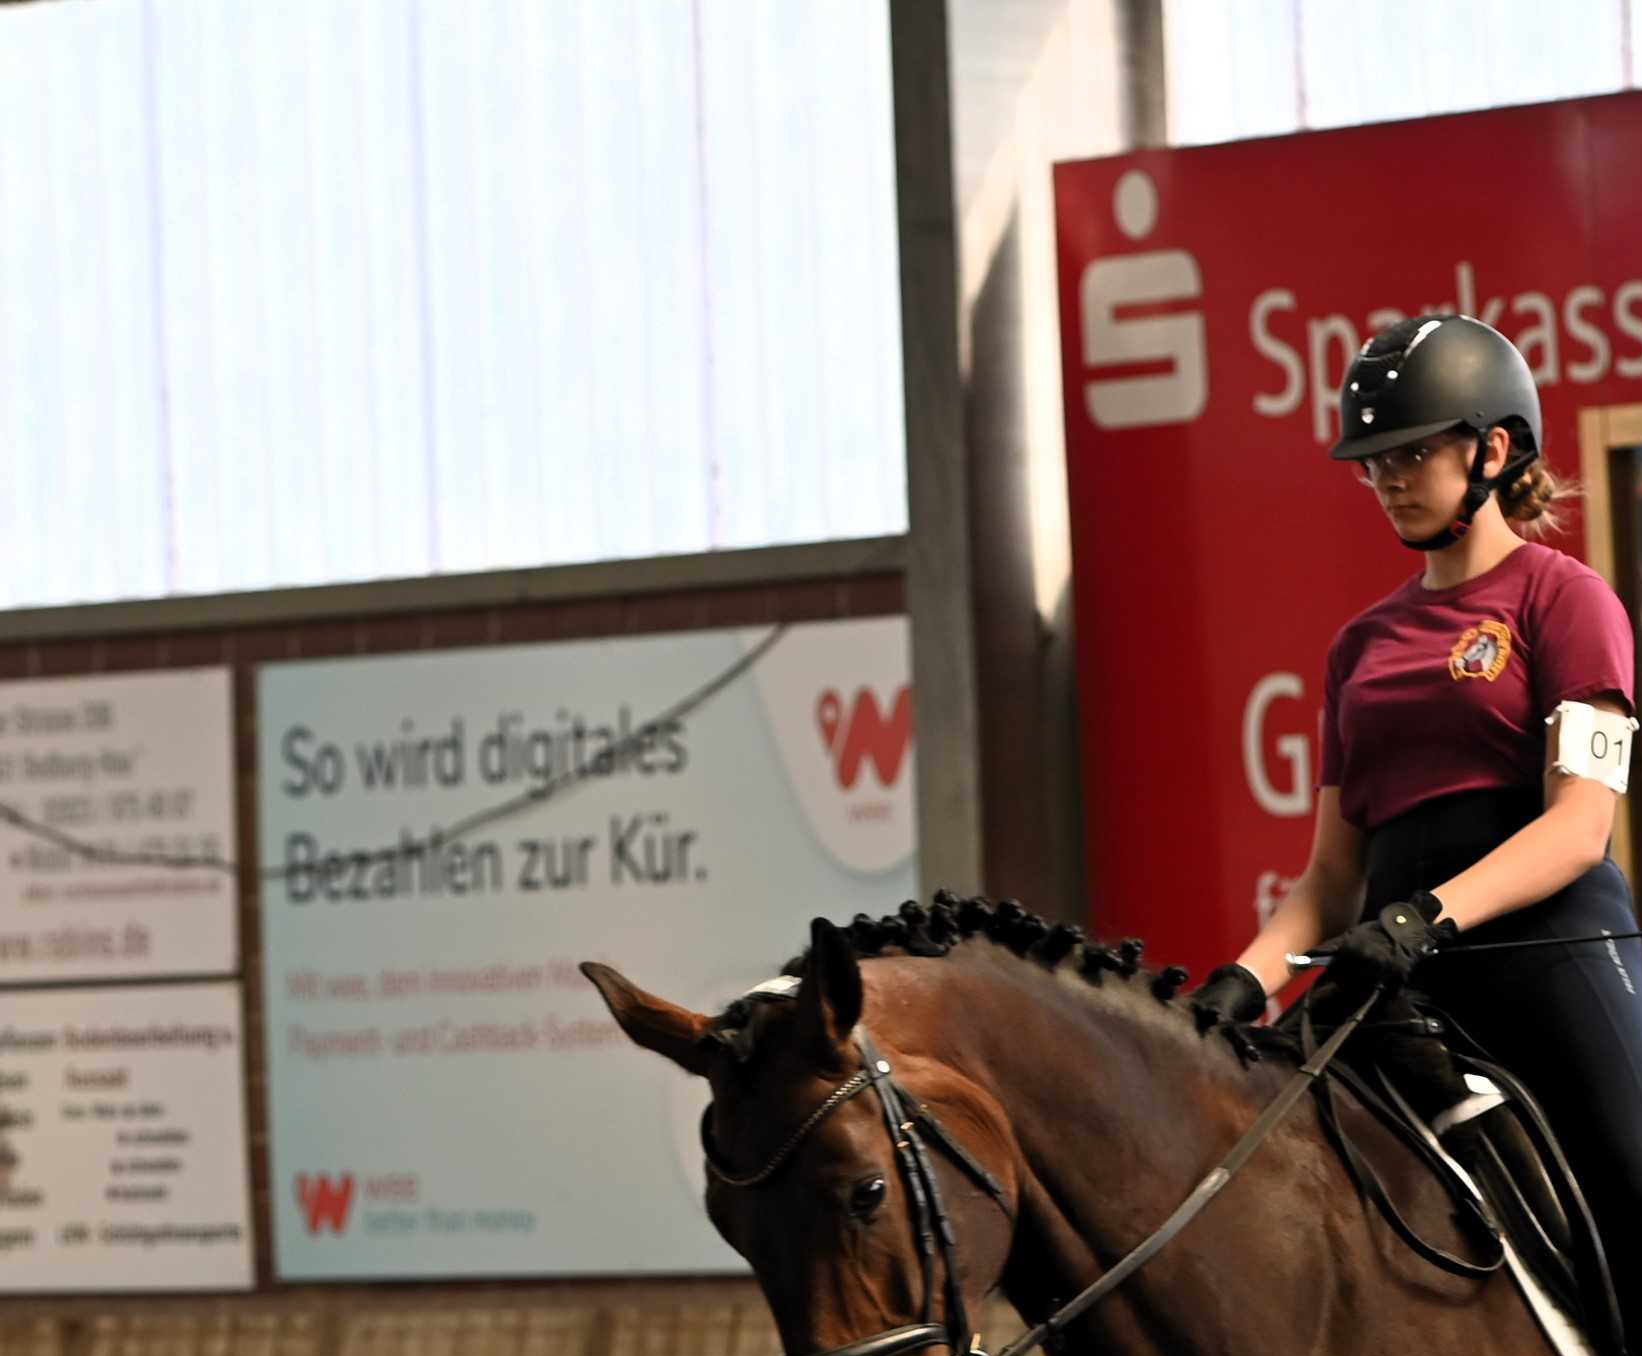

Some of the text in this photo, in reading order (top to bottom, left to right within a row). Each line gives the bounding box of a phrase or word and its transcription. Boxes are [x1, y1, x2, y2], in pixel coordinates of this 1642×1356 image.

[281, 704, 690, 800] So wird digitales
[1591, 731, 1623, 766] 01
[284, 826, 504, 905] Bezahlen
[516, 834, 597, 892] zur
[608, 811, 708, 887] Kür.
